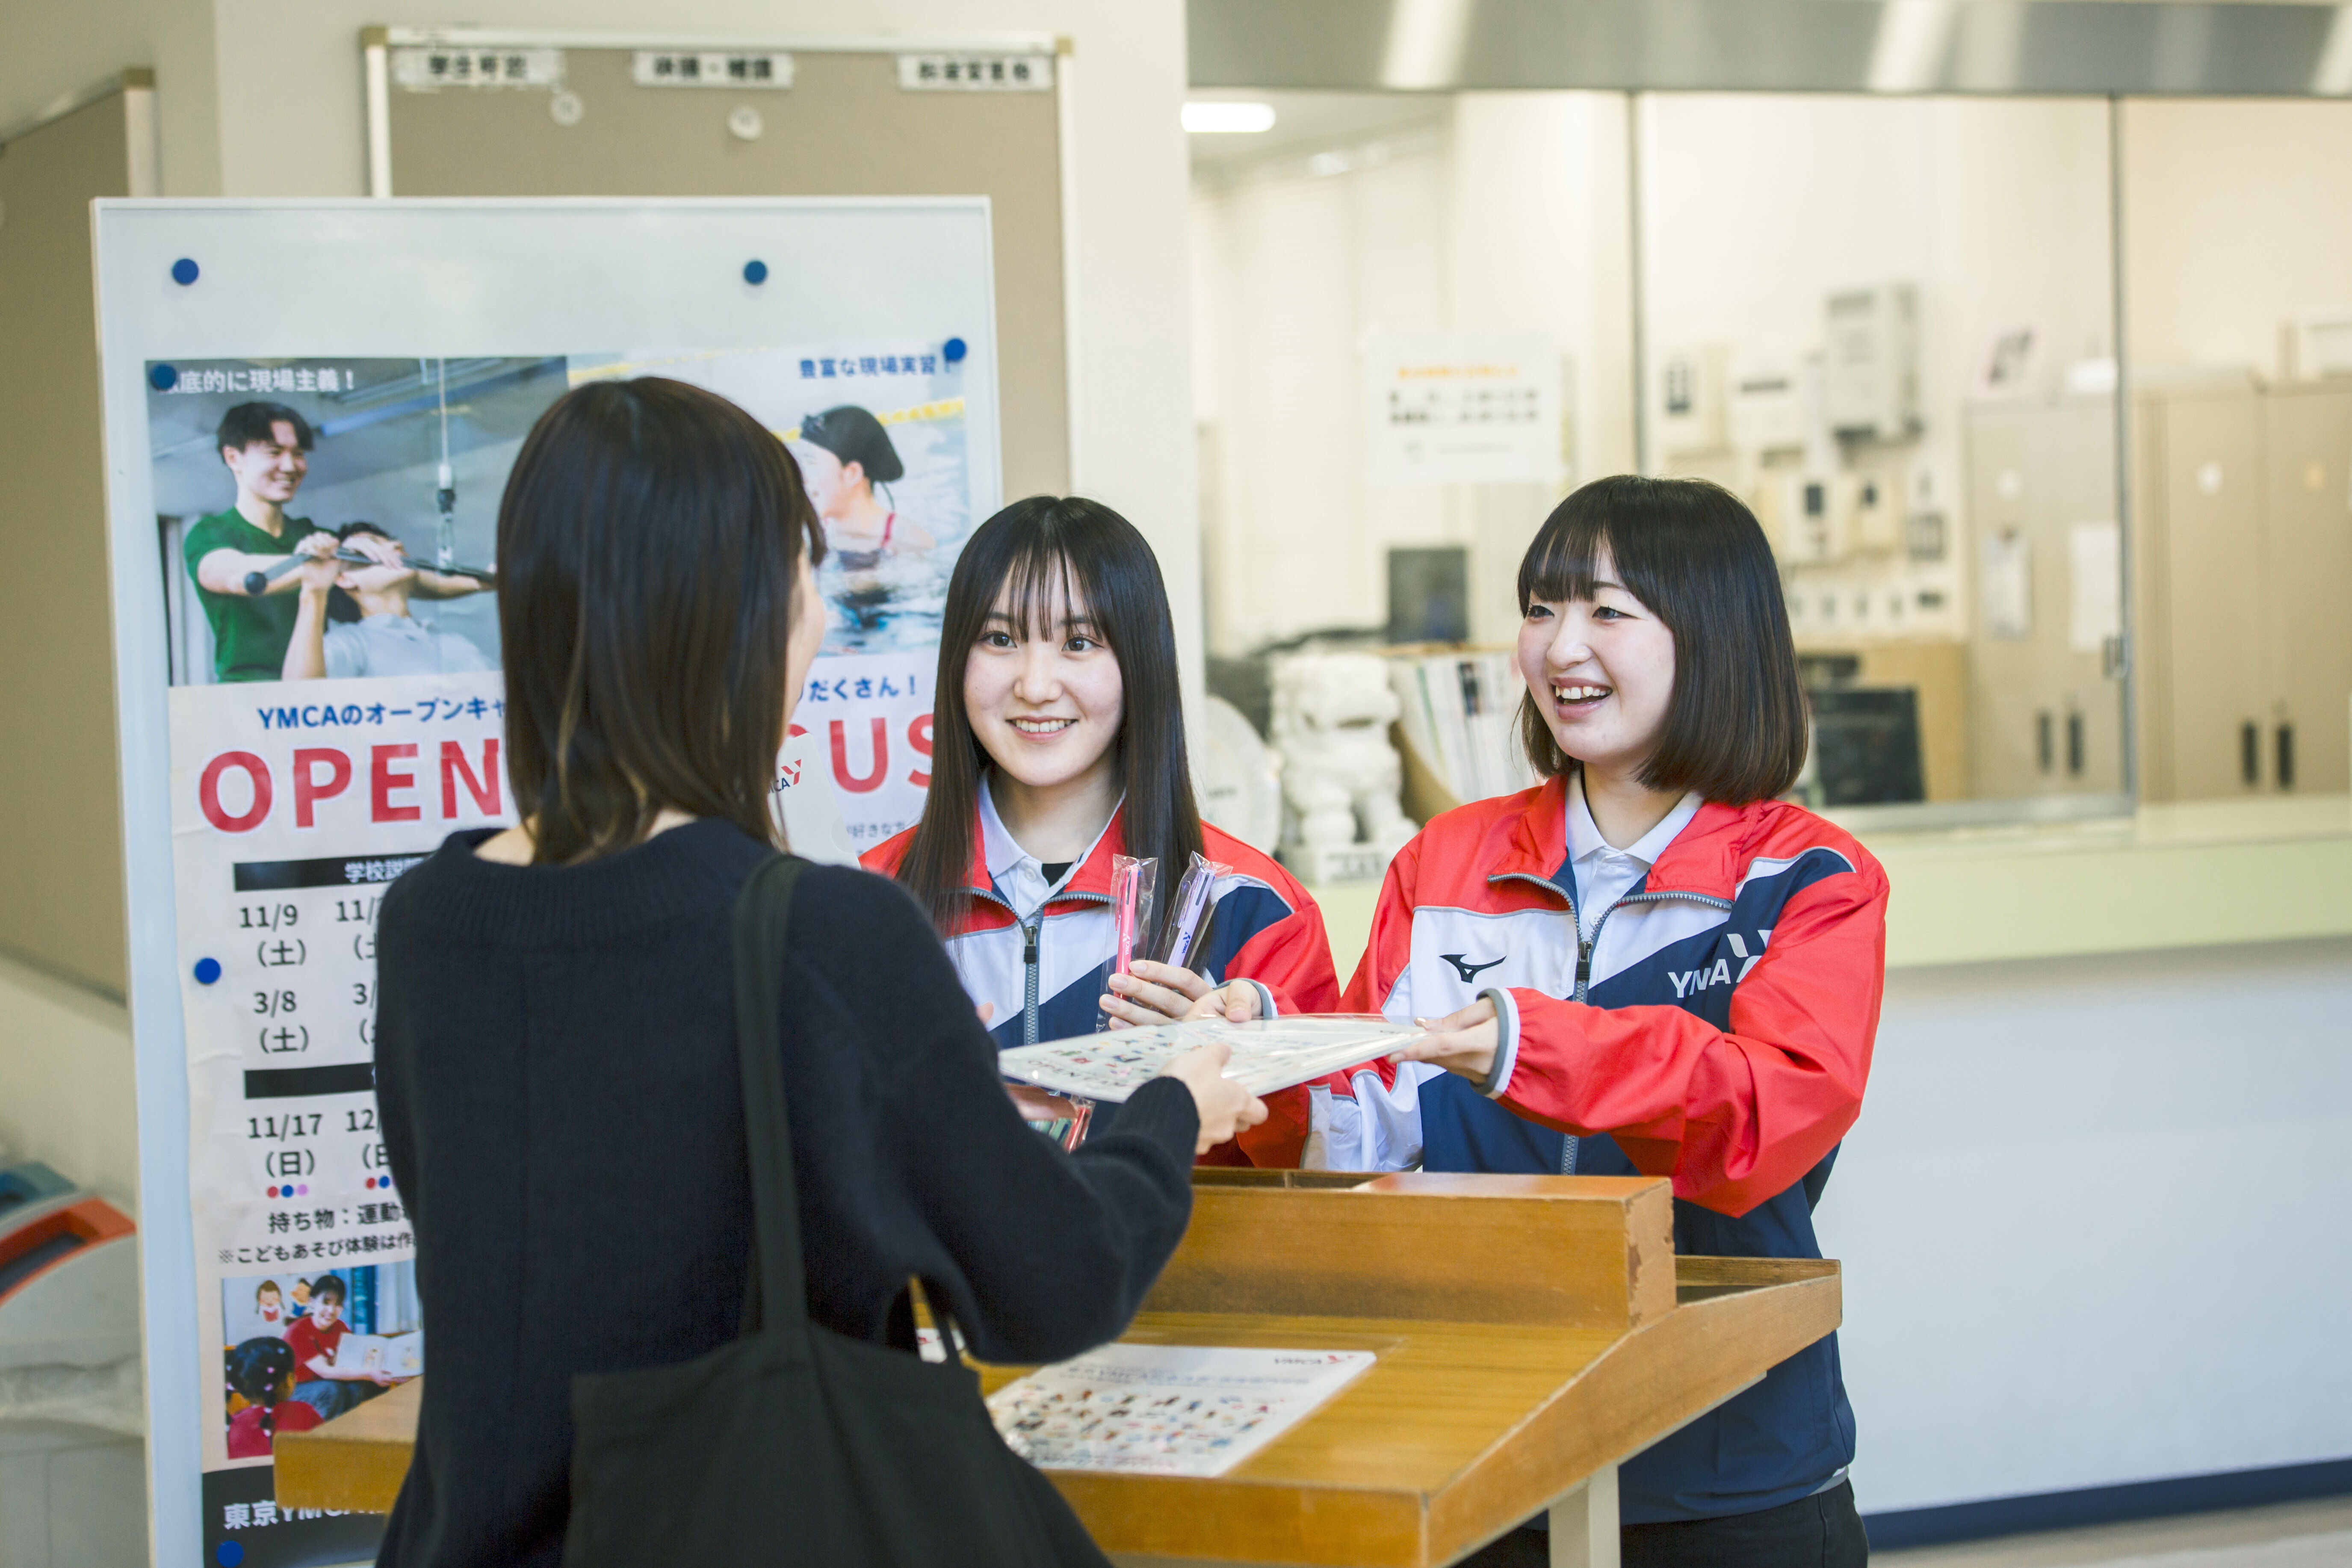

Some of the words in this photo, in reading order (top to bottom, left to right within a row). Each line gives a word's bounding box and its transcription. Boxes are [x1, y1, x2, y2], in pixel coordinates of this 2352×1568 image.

[165, 367, 355, 393] 底的に現場主義！
[800, 675, 916, 702] だくさん！
[199, 738, 502, 833] OPEN
[789, 713, 934, 794] US
[239, 903, 298, 932] 11/9
[336, 896, 381, 925] 11/
[253, 989, 297, 1019] 3/8
[248, 1113, 323, 1143] 11/17
